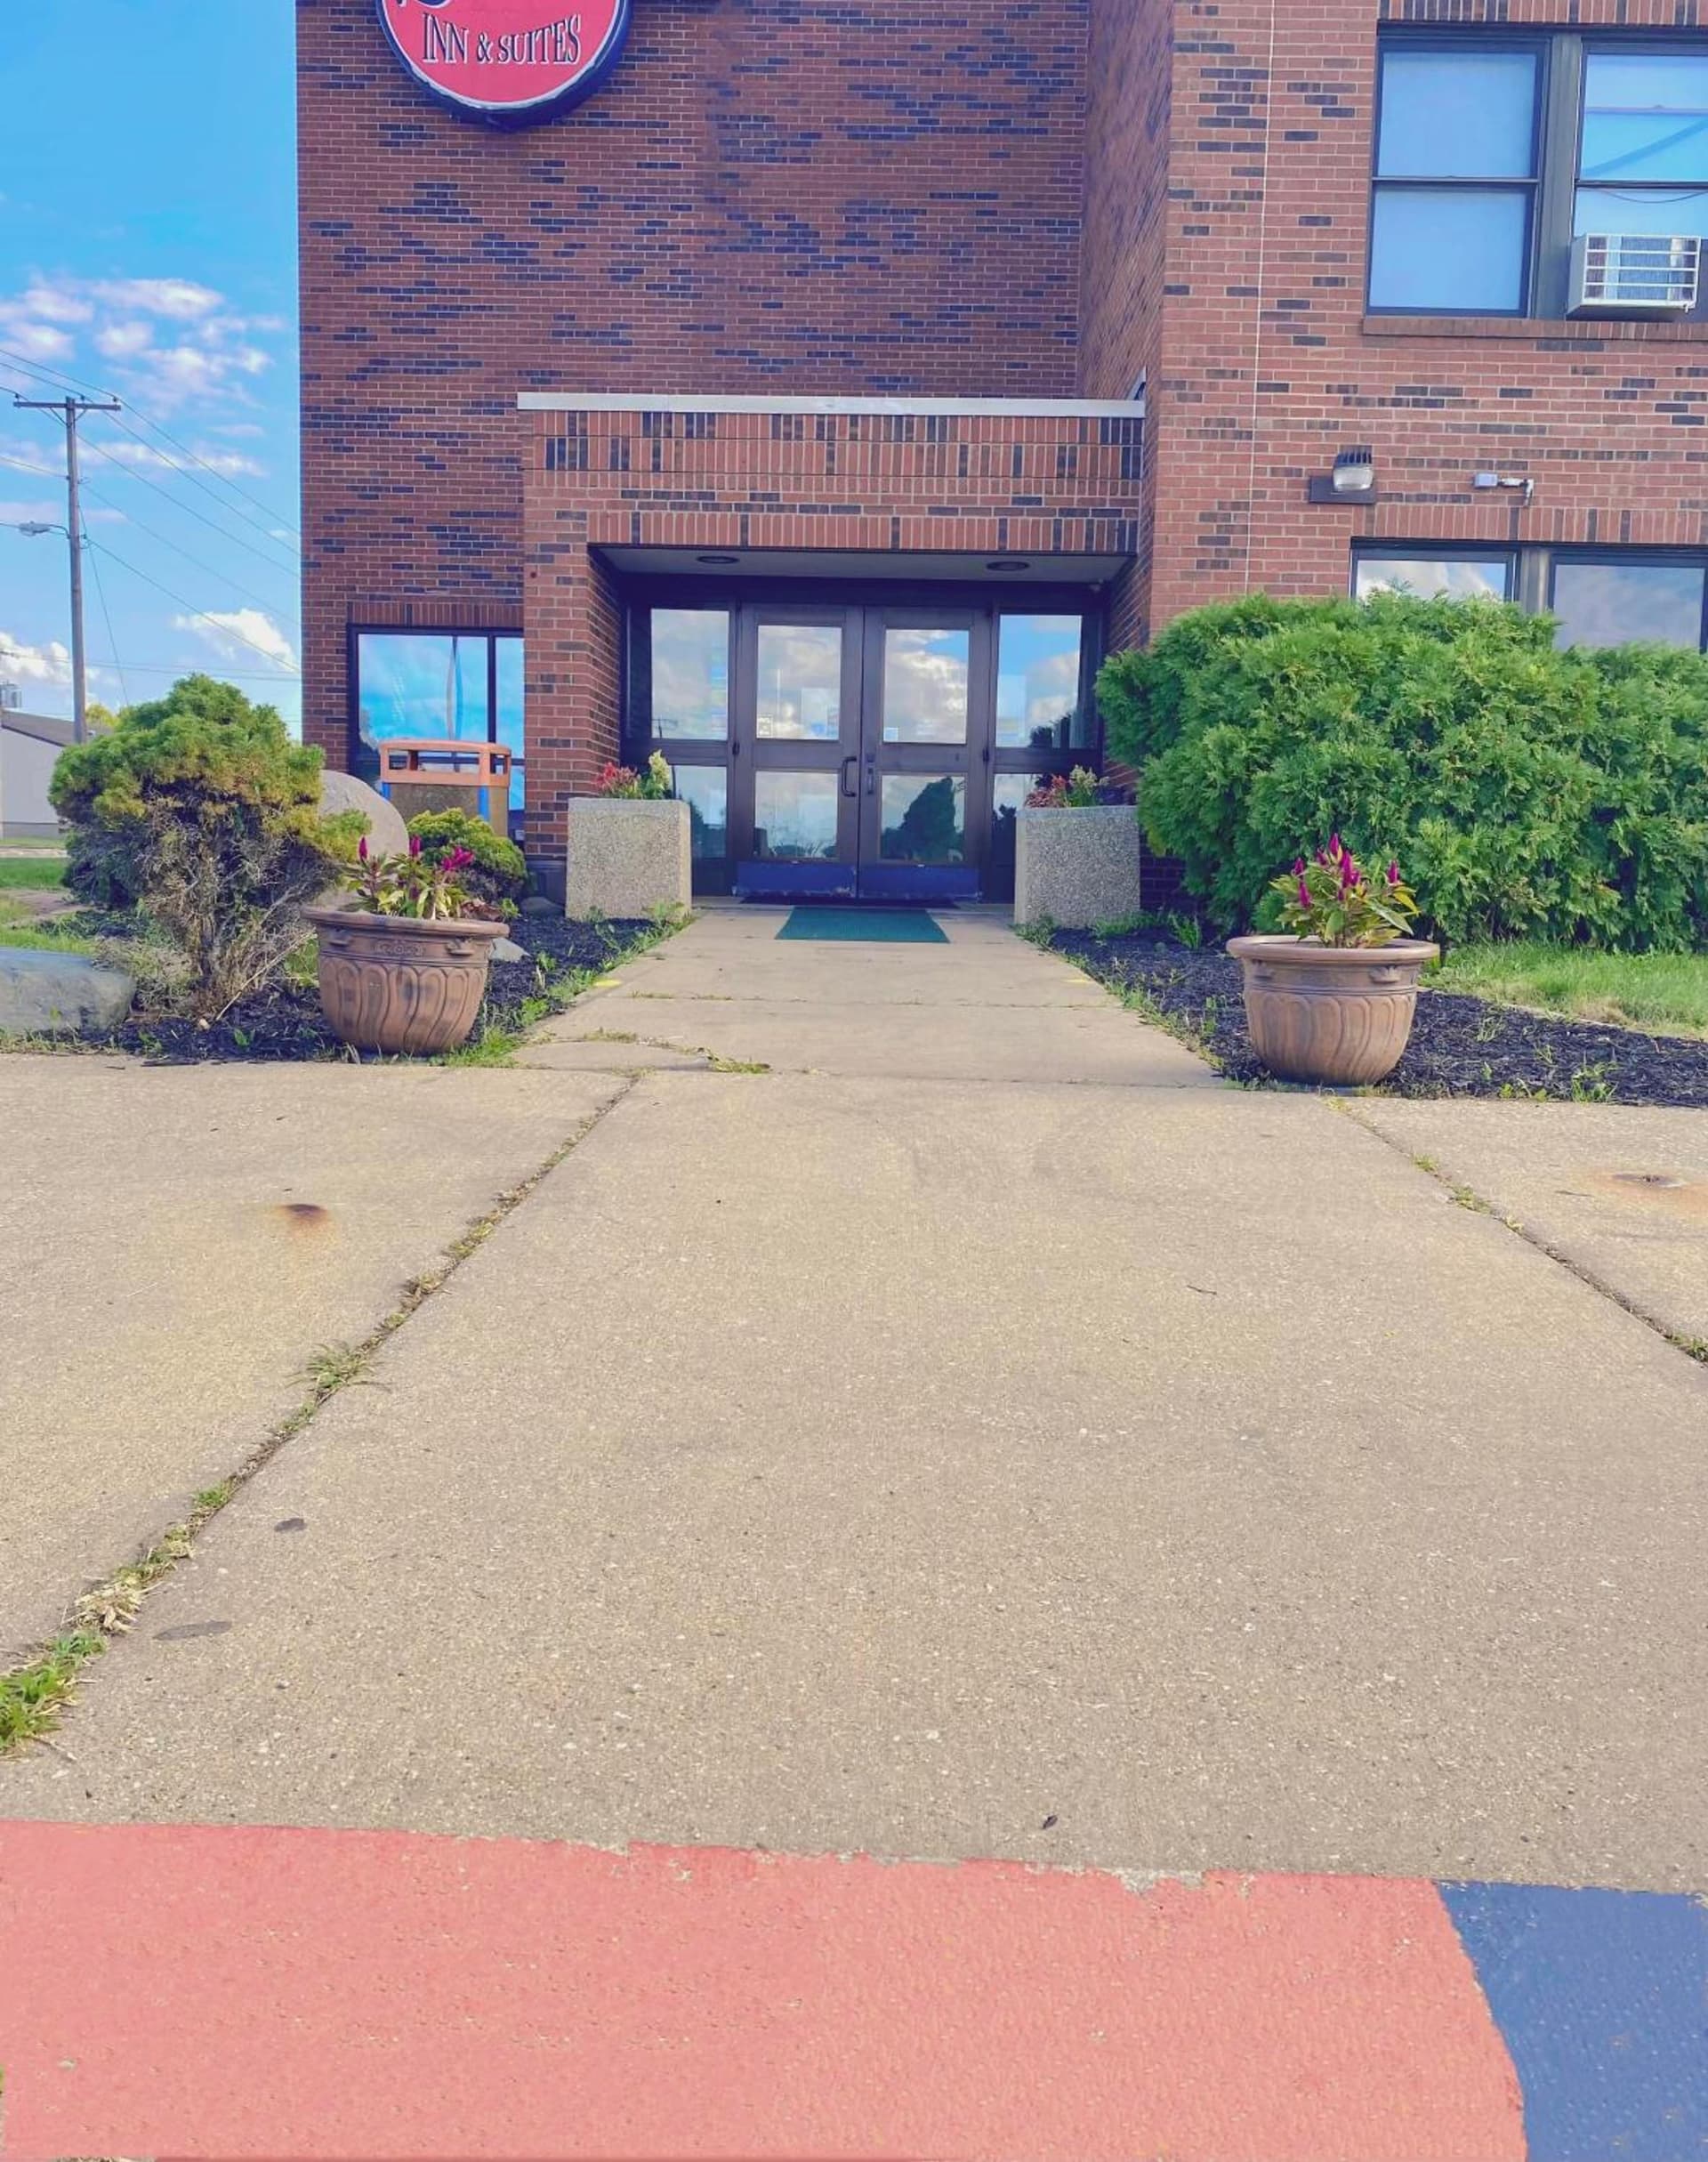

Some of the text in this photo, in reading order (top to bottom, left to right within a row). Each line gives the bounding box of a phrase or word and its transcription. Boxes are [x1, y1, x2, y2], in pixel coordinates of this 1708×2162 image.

[423, 12, 582, 65] INN & SUITES
